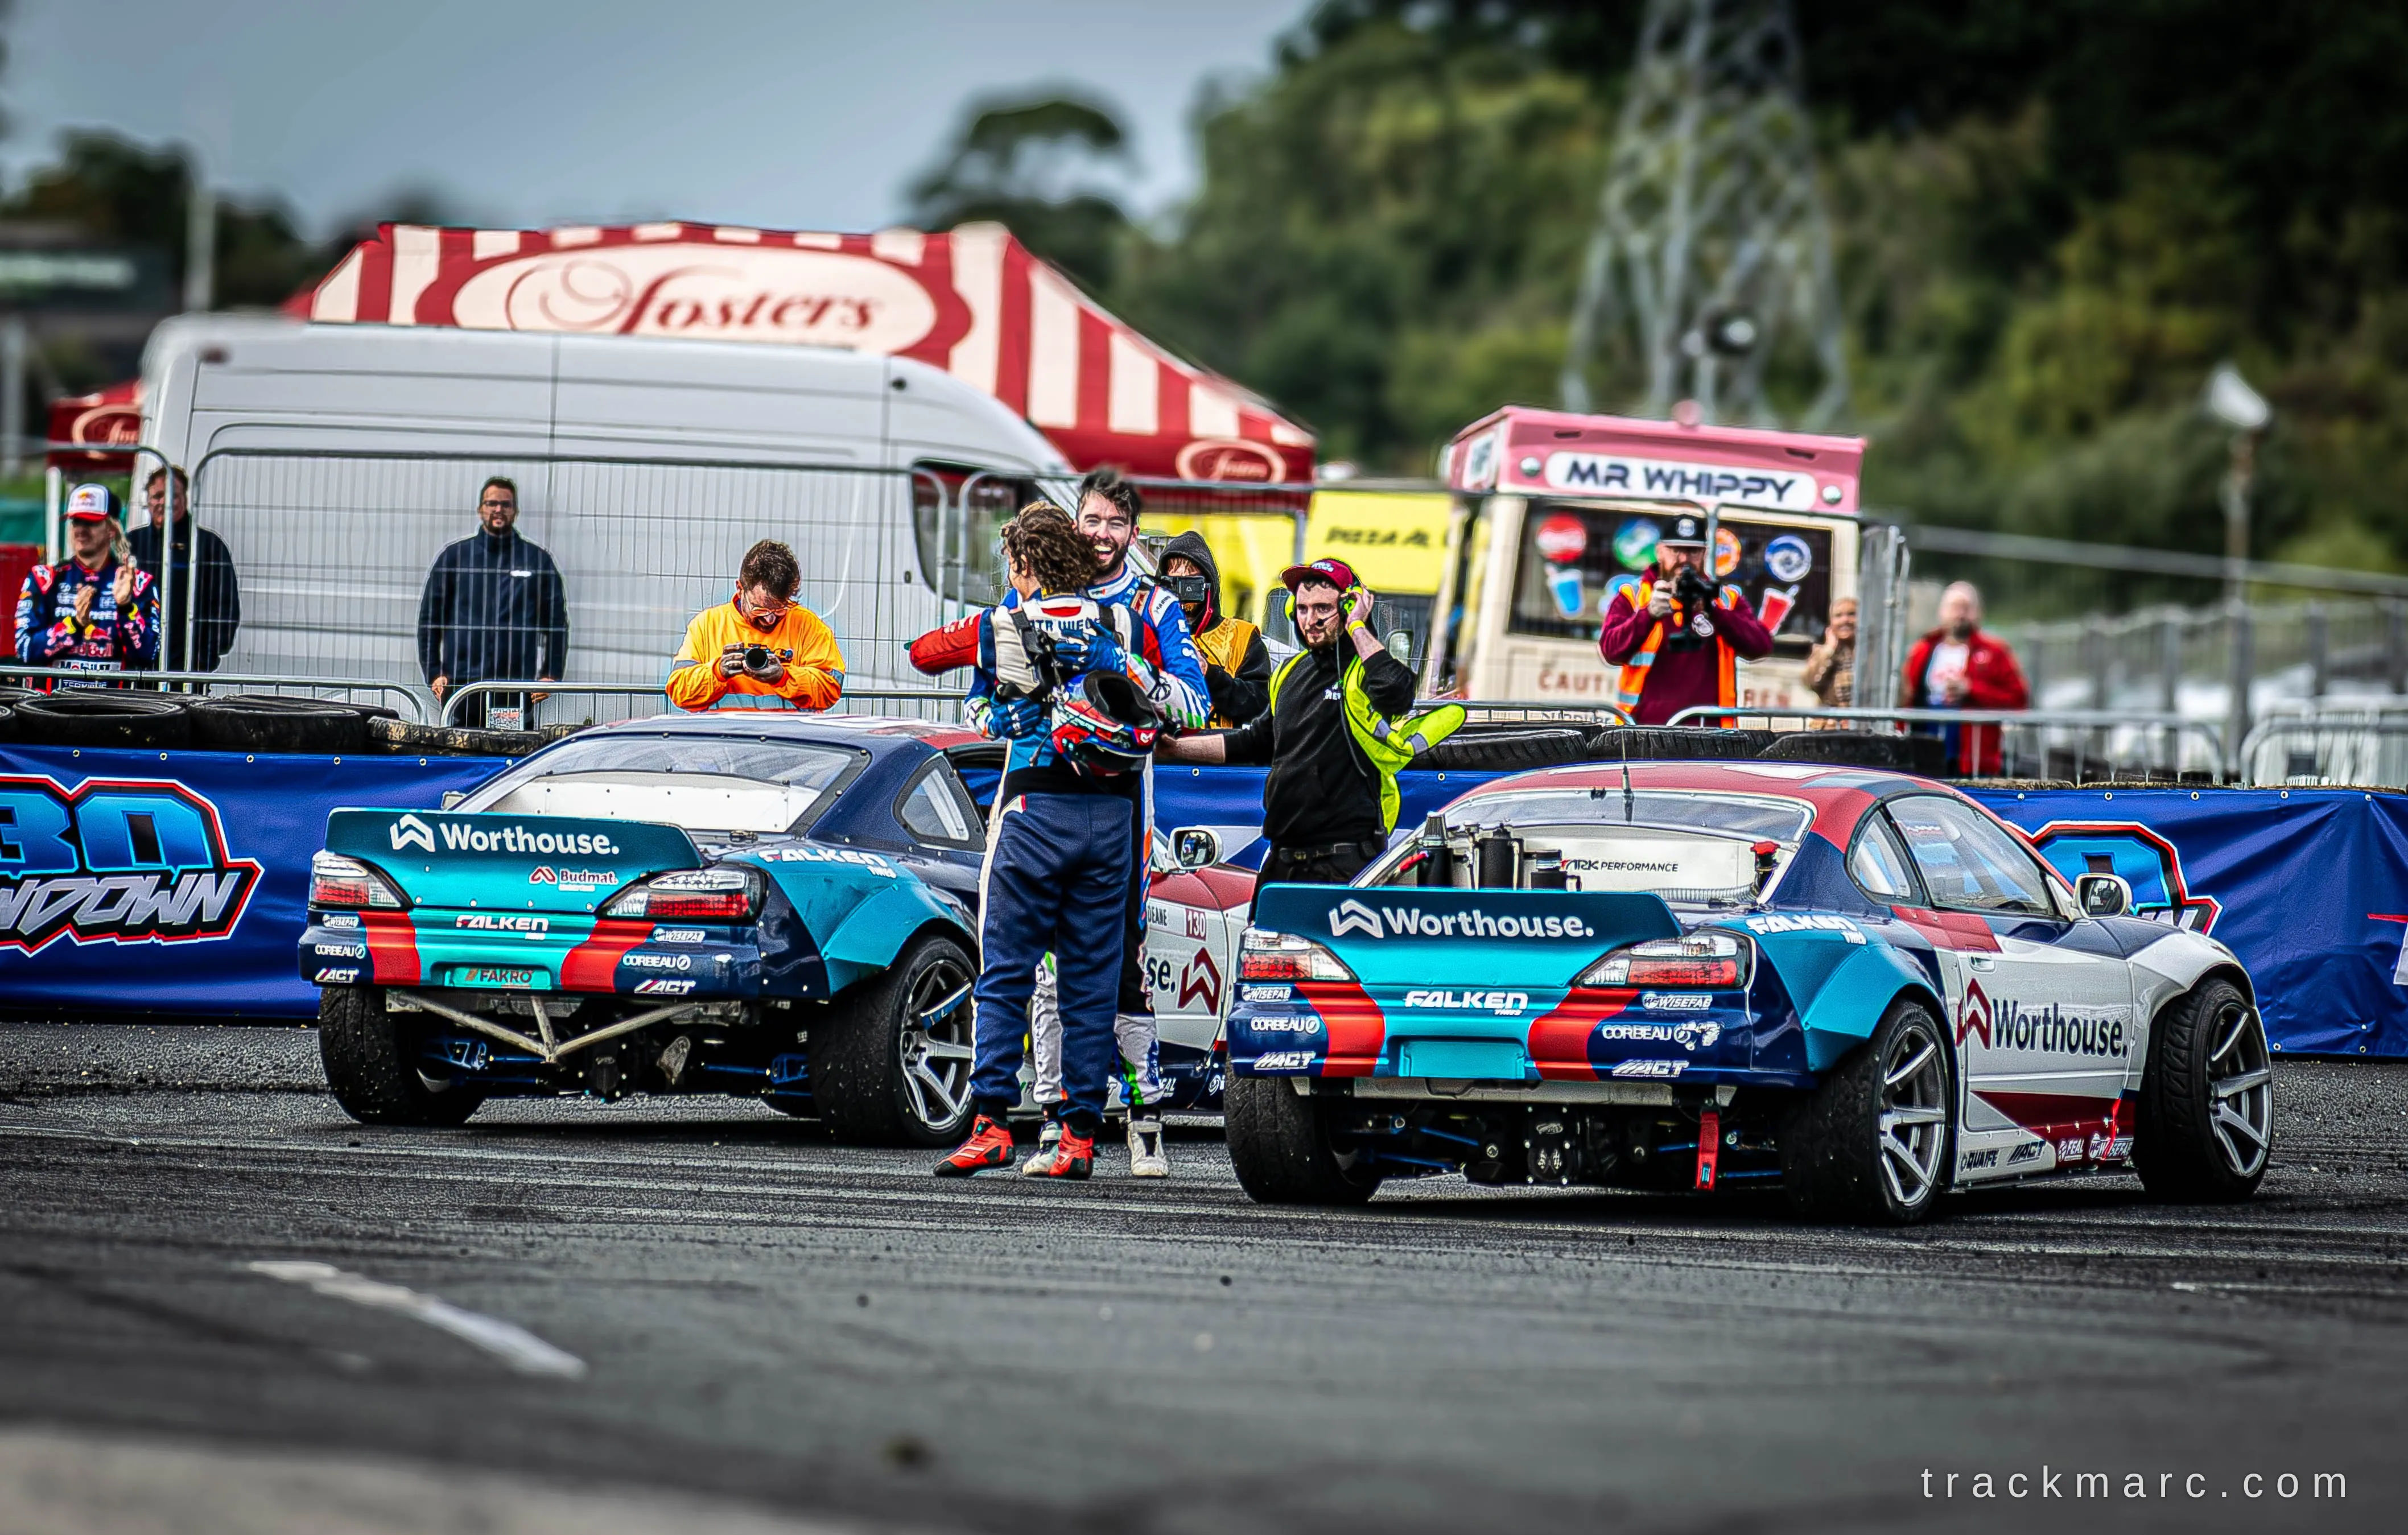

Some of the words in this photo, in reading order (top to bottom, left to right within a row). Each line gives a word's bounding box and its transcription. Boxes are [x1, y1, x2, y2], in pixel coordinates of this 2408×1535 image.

[504, 258, 878, 334] Fosters
[1566, 459, 1633, 488] MR
[1644, 467, 1797, 502] WHIPPY
[439, 822, 620, 855] Worthouse.
[758, 848, 889, 867] FALKEN
[1600, 861, 1679, 872] PERFORMANCE
[456, 914, 549, 931] FALKEN
[1187, 911, 1206, 938] 130
[1382, 906, 1594, 938] Worthouse.
[1745, 915, 1858, 935] FALKEN
[315, 944, 354, 957] CORBEAU
[623, 954, 677, 968] CORBEAU
[479, 969, 533, 983] FAKRO
[1403, 990, 1528, 1010] FALKEN
[1251, 1016, 1305, 1031] CORBEAU
[1602, 1025, 1672, 1041] CORBEAU
[1993, 998, 2128, 1059] Worthouse.
[2066, 1138, 2084, 1155] FEAL
